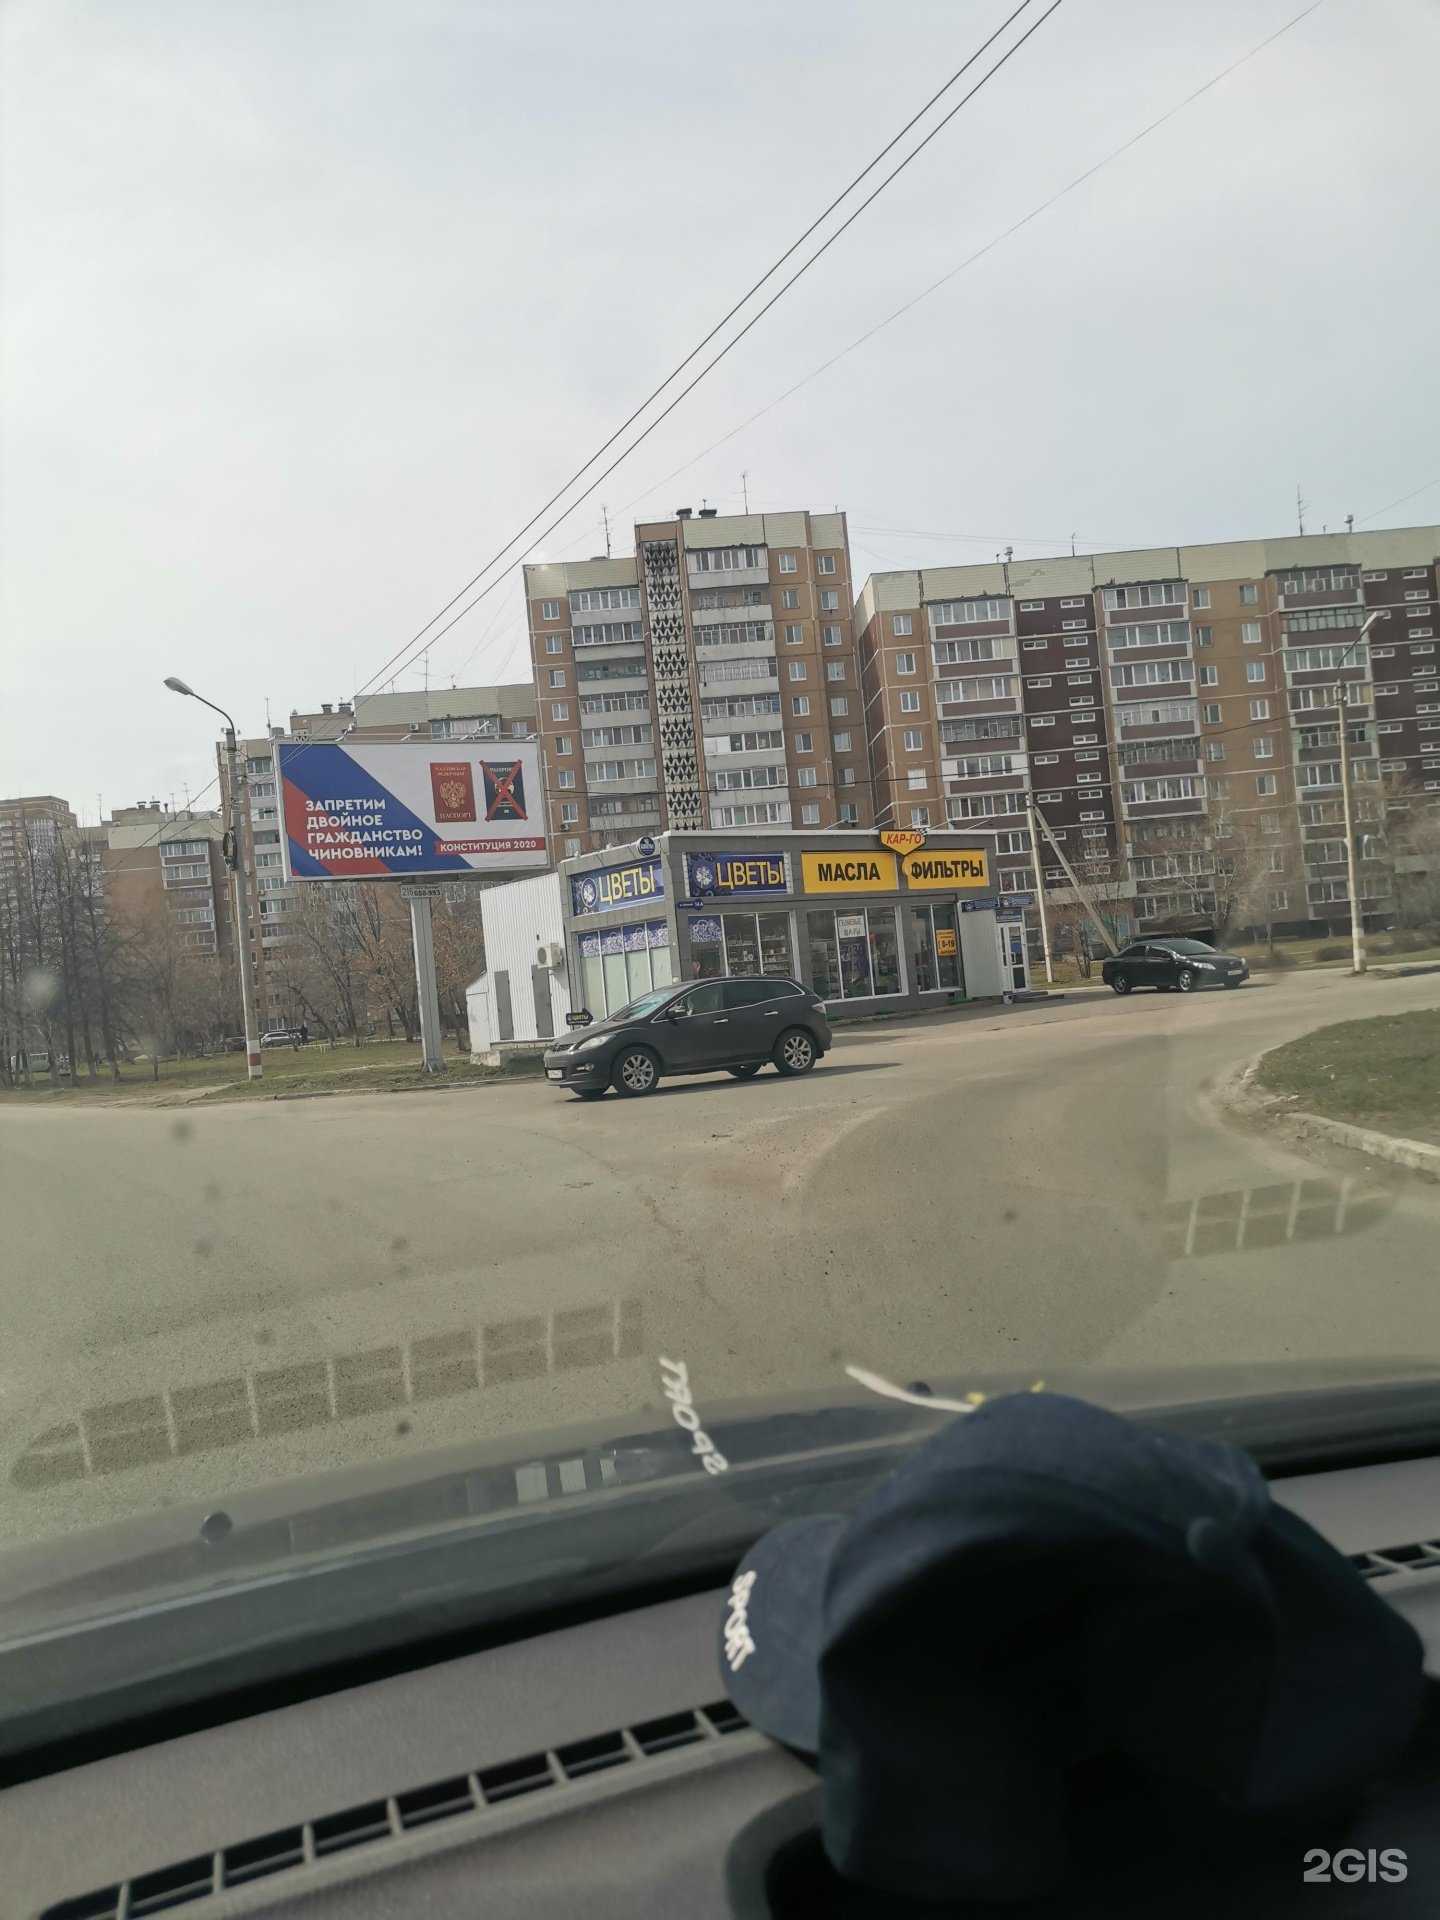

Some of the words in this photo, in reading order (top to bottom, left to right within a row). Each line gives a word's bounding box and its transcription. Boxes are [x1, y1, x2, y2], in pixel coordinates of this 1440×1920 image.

[305, 798, 386, 812] ЗАПРЕТИМ
[306, 812, 383, 830] ДВОЙНОЕ
[307, 829, 423, 845] ГРАЖДАНСТВО
[440, 841, 512, 852] КОНСТИТУЦИЯ
[514, 839, 537, 849] 2020
[885, 833, 922, 845] КАР-ГО
[308, 845, 423, 861] ЧИНОВНИКАМ!
[716, 861, 785, 890] ЦВЕТЫ
[817, 862, 881, 882] МАСЛА
[910, 860, 984, 879] ФИЛЬТРЫ
[598, 865, 656, 904] ЦВЕТЫ
